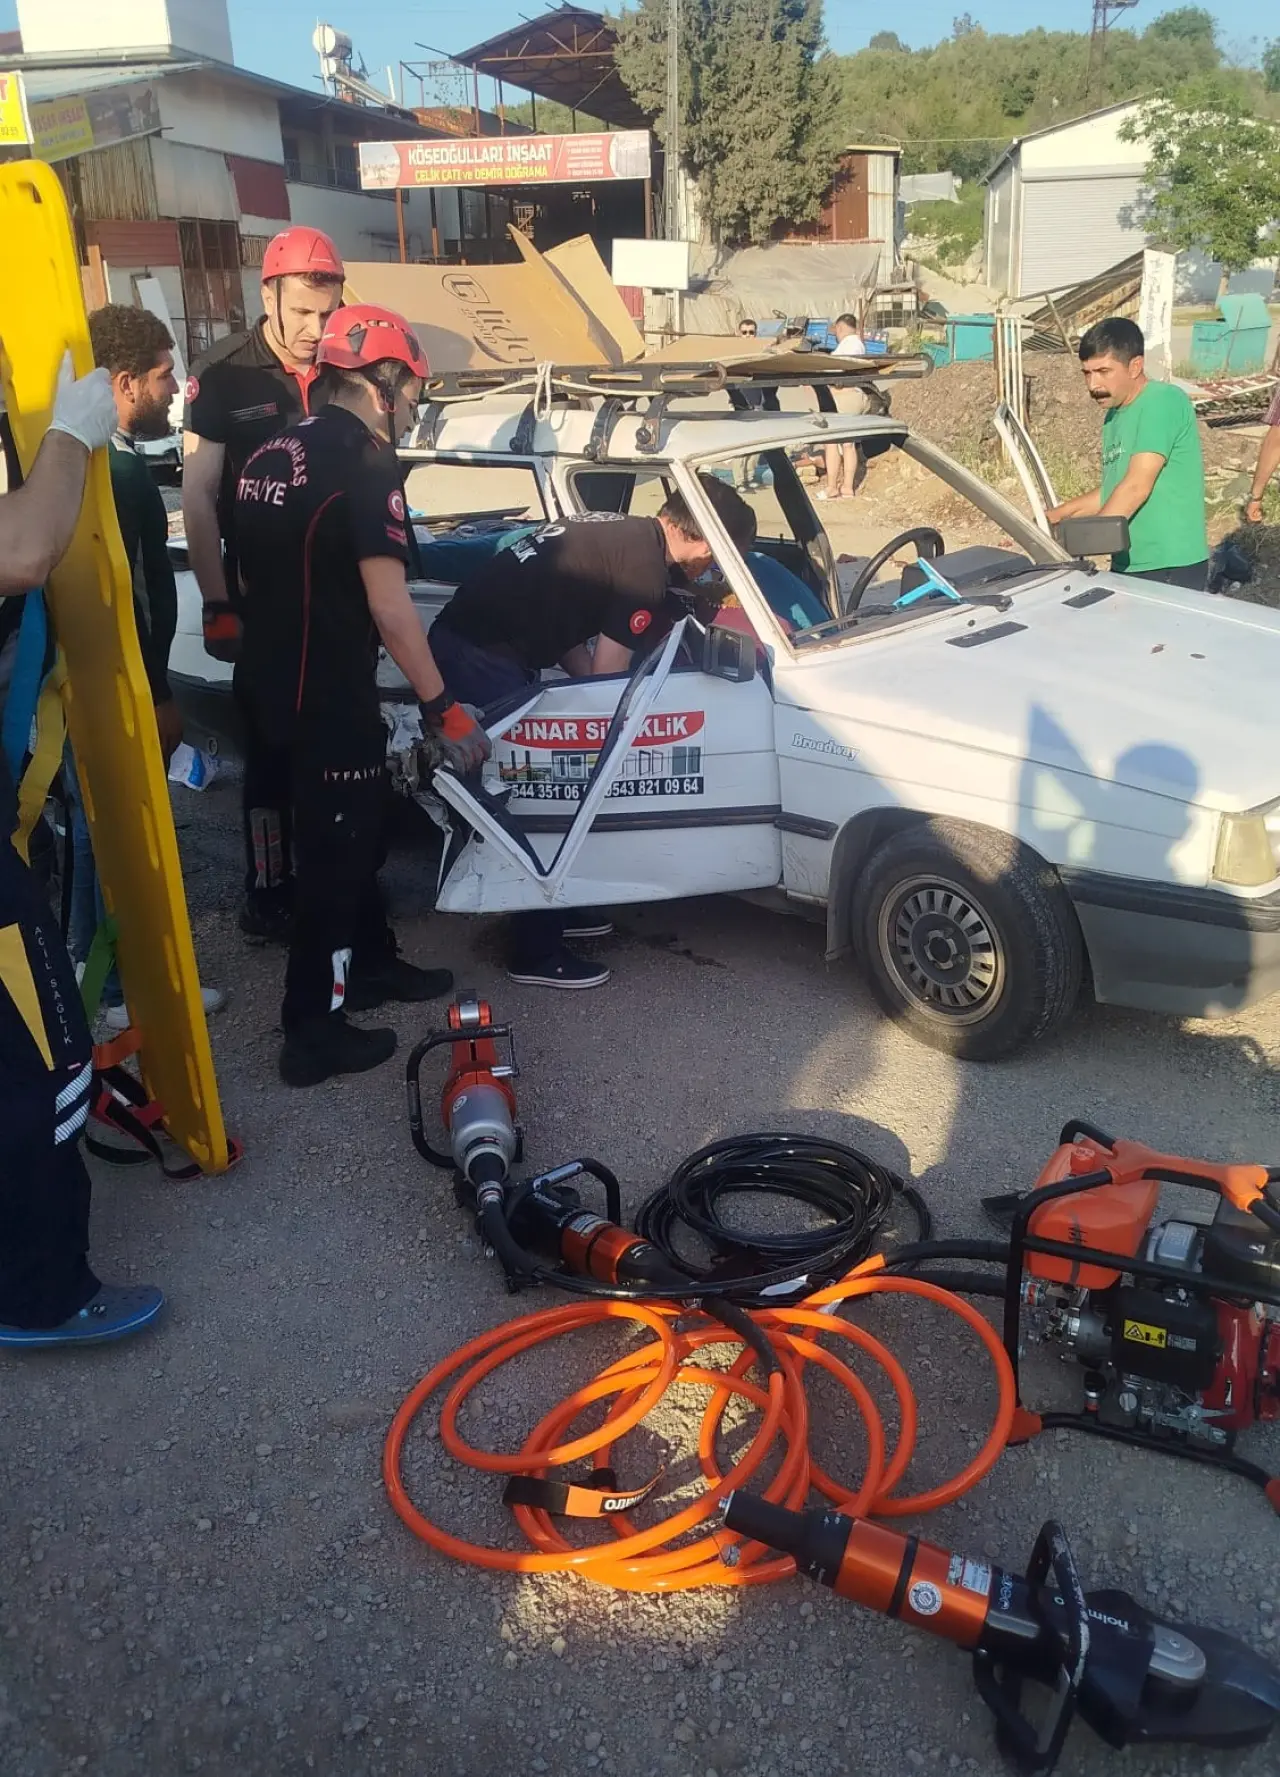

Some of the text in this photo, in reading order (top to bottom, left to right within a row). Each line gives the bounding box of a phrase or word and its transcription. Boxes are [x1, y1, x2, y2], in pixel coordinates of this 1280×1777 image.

[506, 141, 553, 163] İNŞAAT
[511, 716, 688, 740] PINAR SiKLiK
[791, 733, 860, 761] Broadway
[511, 784, 535, 798] 544
[538, 784, 560, 798] 351
[564, 784, 579, 799] 06
[638, 780, 660, 795] 821
[664, 778, 680, 794] 09
[683, 778, 699, 793] 64
